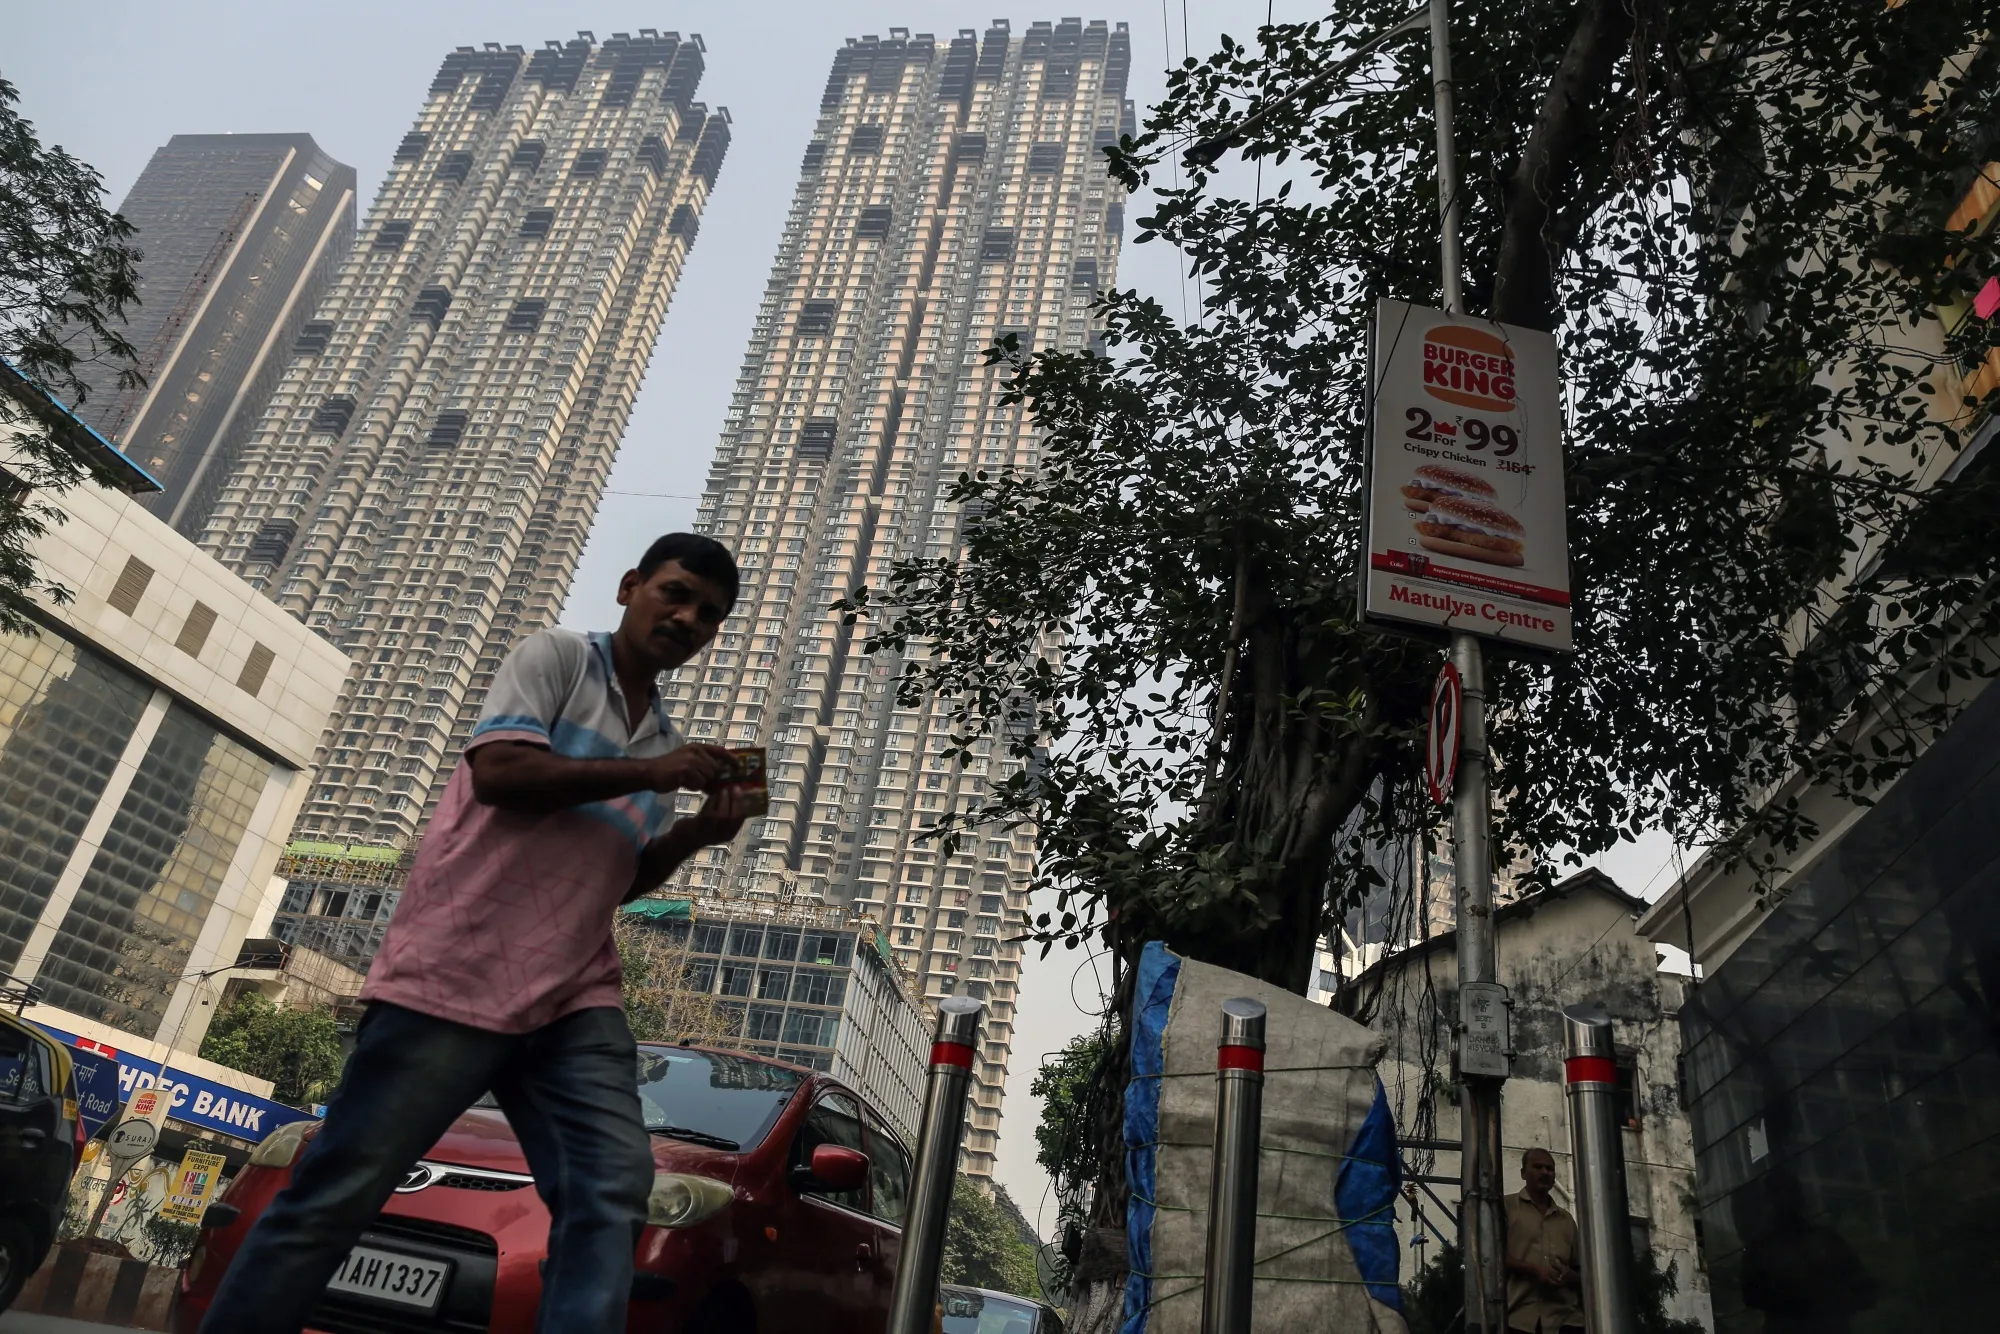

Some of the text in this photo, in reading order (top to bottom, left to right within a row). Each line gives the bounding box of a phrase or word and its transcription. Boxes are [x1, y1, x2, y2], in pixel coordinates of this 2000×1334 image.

[1424, 343, 1515, 377] BURGER
[1424, 360, 1516, 399] KING
[1405, 407, 1432, 441] 2
[1434, 434, 1457, 446] For
[1404, 443, 1487, 467] Crispy Chicken
[1470, 575, 1485, 583] Burger
[1389, 584, 1476, 616] Matulya
[1481, 603, 1555, 632] Centre
[79, 1063, 99, 1083] मार्ग
[85, 1093, 113, 1114] Road
[135, 1103, 154, 1111] KING
[192, 1090, 267, 1132] BANK
[125, 1135, 152, 1144] SURAJ
[187, 1156, 220, 1167] FURNITURE
